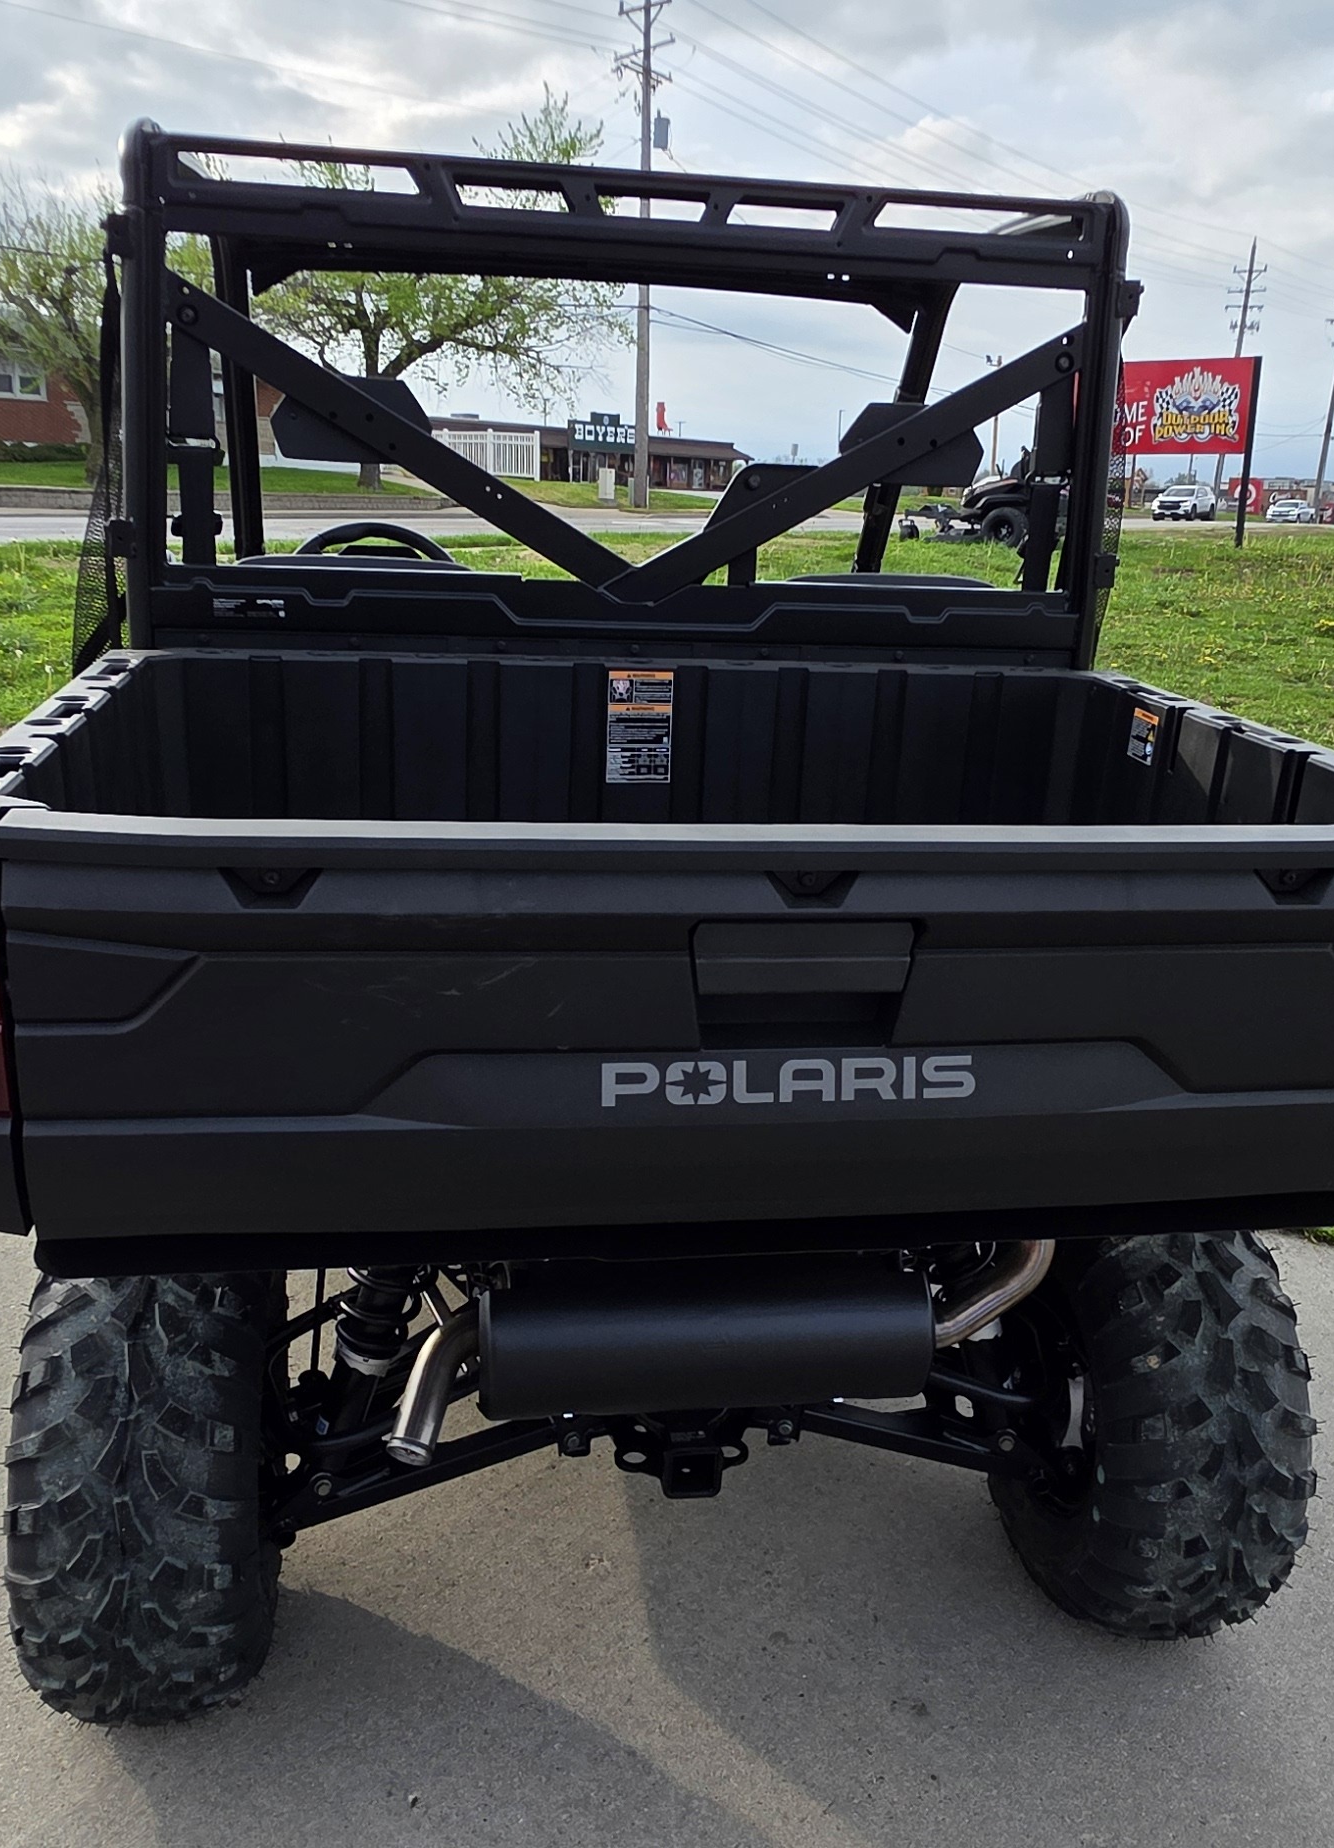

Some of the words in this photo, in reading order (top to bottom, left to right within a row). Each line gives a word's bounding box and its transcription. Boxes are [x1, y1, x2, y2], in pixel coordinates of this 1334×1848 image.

[1163, 409, 1230, 425] OUTDOOR
[574, 423, 635, 444] BOYER'S
[1121, 425, 1146, 447] OF
[1155, 423, 1205, 441] POWER
[601, 1054, 977, 1107] POLARIS
